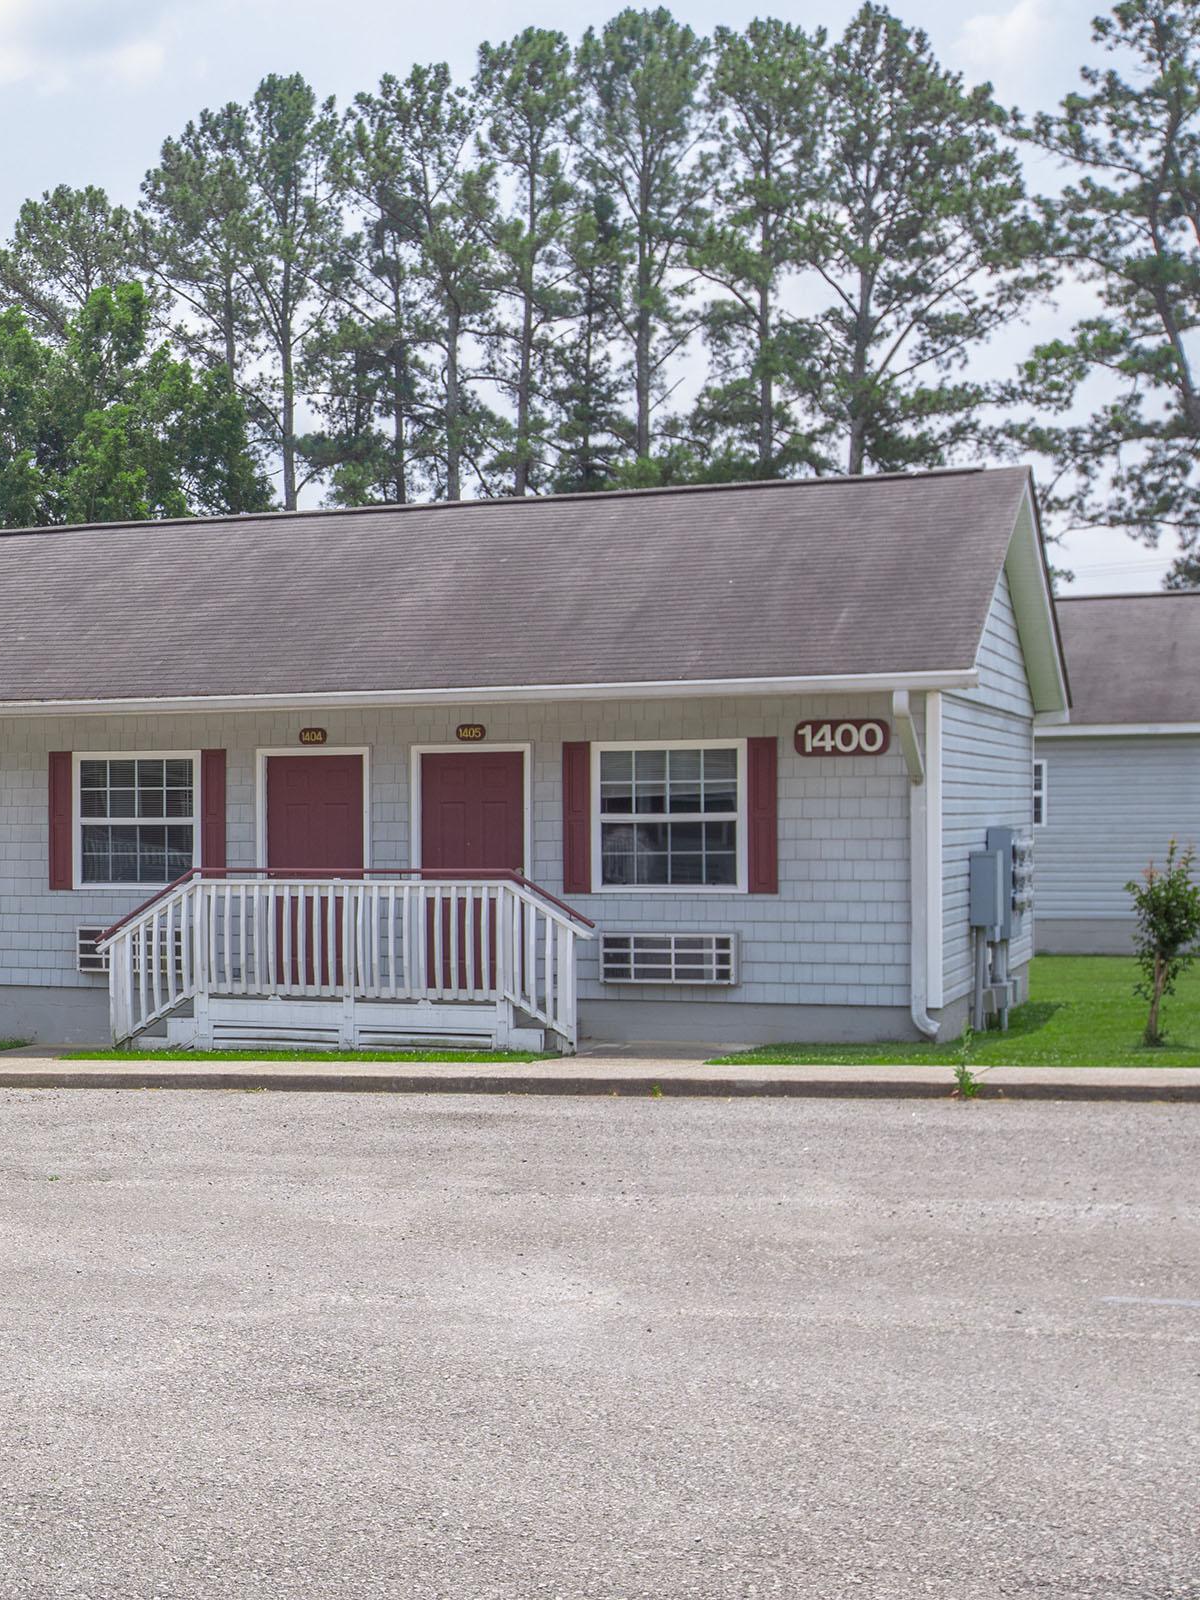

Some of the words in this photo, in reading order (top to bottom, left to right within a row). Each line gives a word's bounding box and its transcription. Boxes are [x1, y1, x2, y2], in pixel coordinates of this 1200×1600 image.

[302, 731, 323, 741] 1404
[458, 727, 481, 738] 1405
[797, 722, 884, 752] 1400
